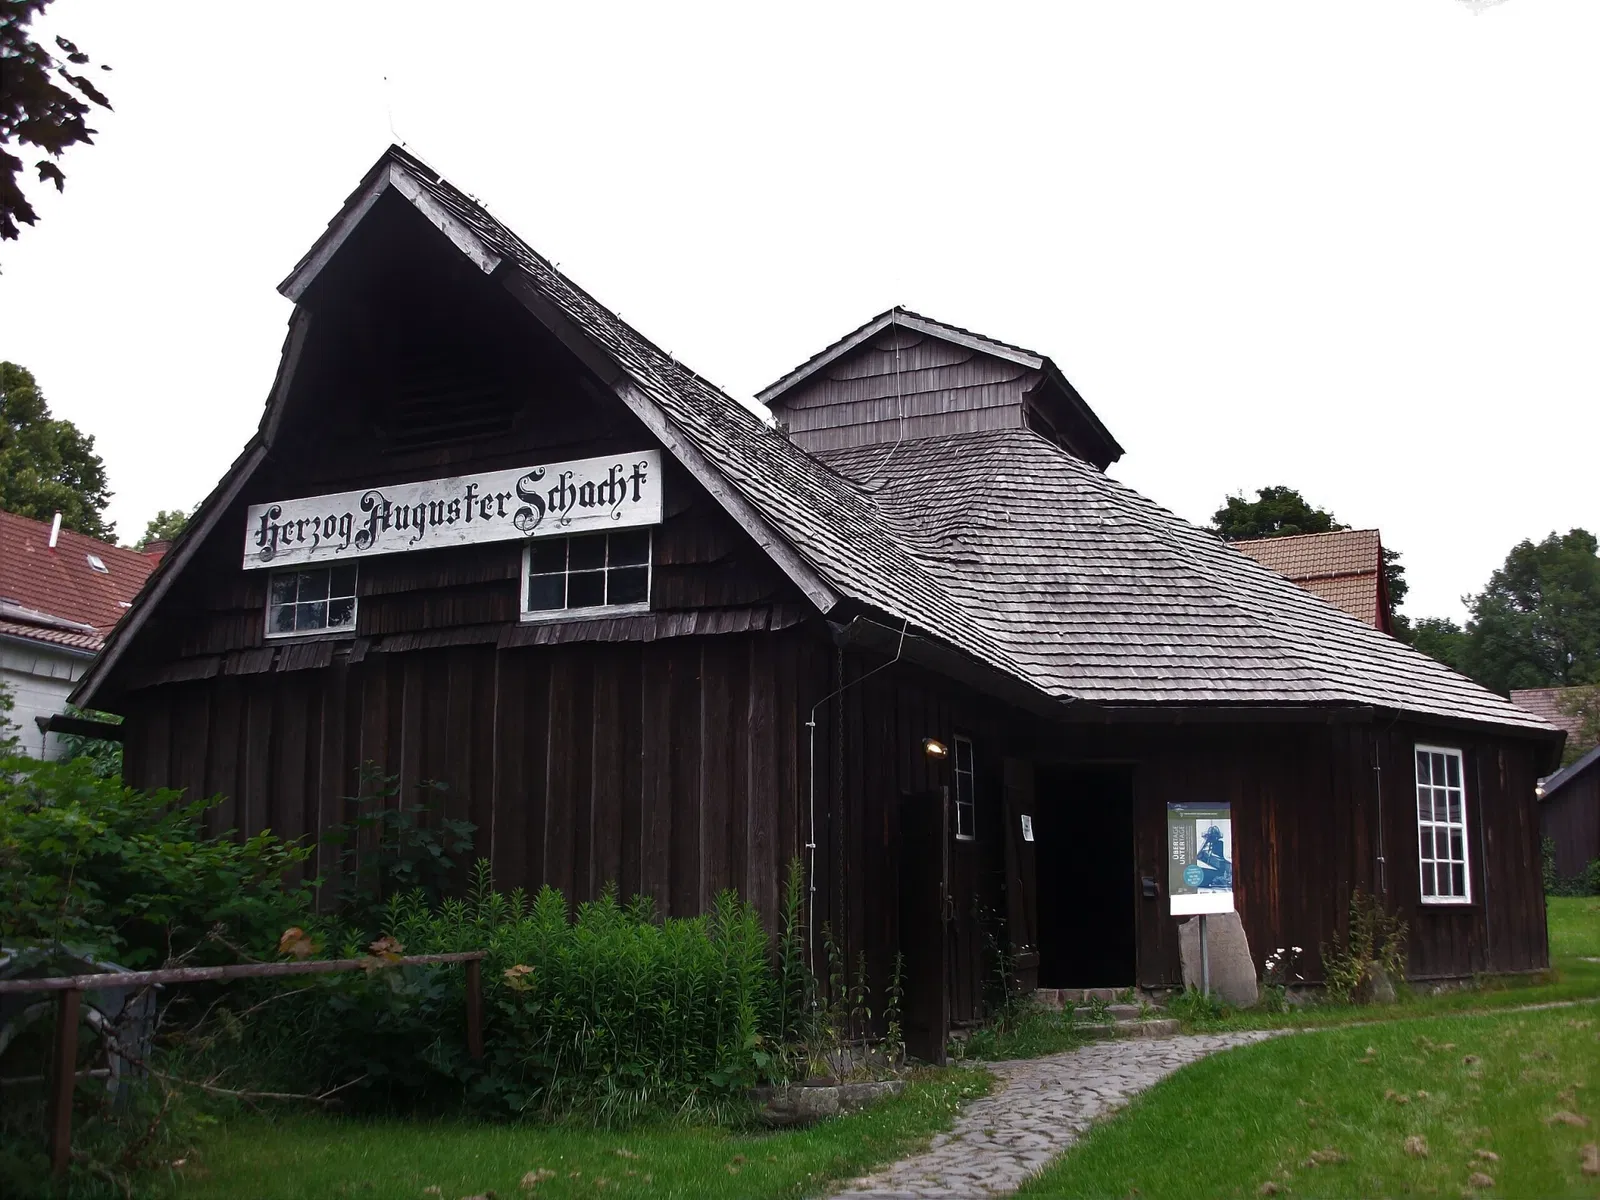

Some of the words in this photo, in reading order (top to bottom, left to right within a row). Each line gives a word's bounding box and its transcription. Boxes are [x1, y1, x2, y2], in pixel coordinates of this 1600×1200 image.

[254, 504, 355, 563] Herzog
[355, 483, 512, 551] Auguster
[513, 460, 648, 537] Schacht
